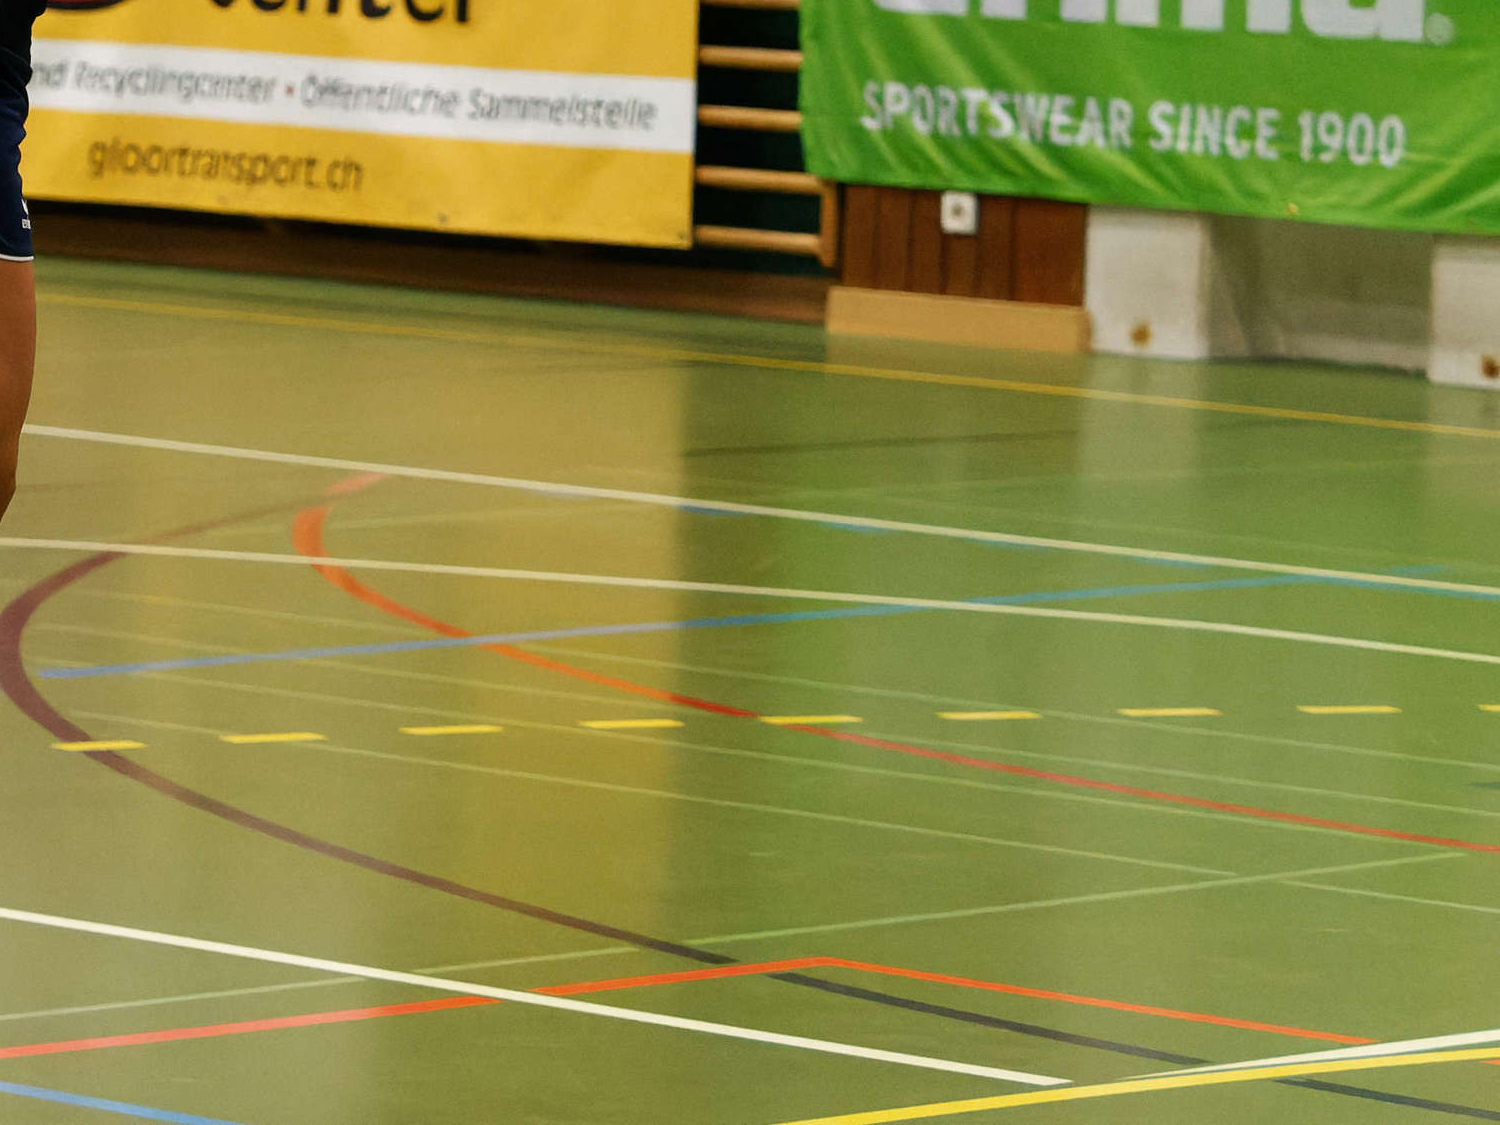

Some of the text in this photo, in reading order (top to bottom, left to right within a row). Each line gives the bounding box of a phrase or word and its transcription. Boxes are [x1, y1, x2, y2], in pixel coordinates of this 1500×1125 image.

[859, 80, 1408, 169] SPORTSWEAR SINCE 1900
[87, 137, 364, 193] gloortransport.ch
